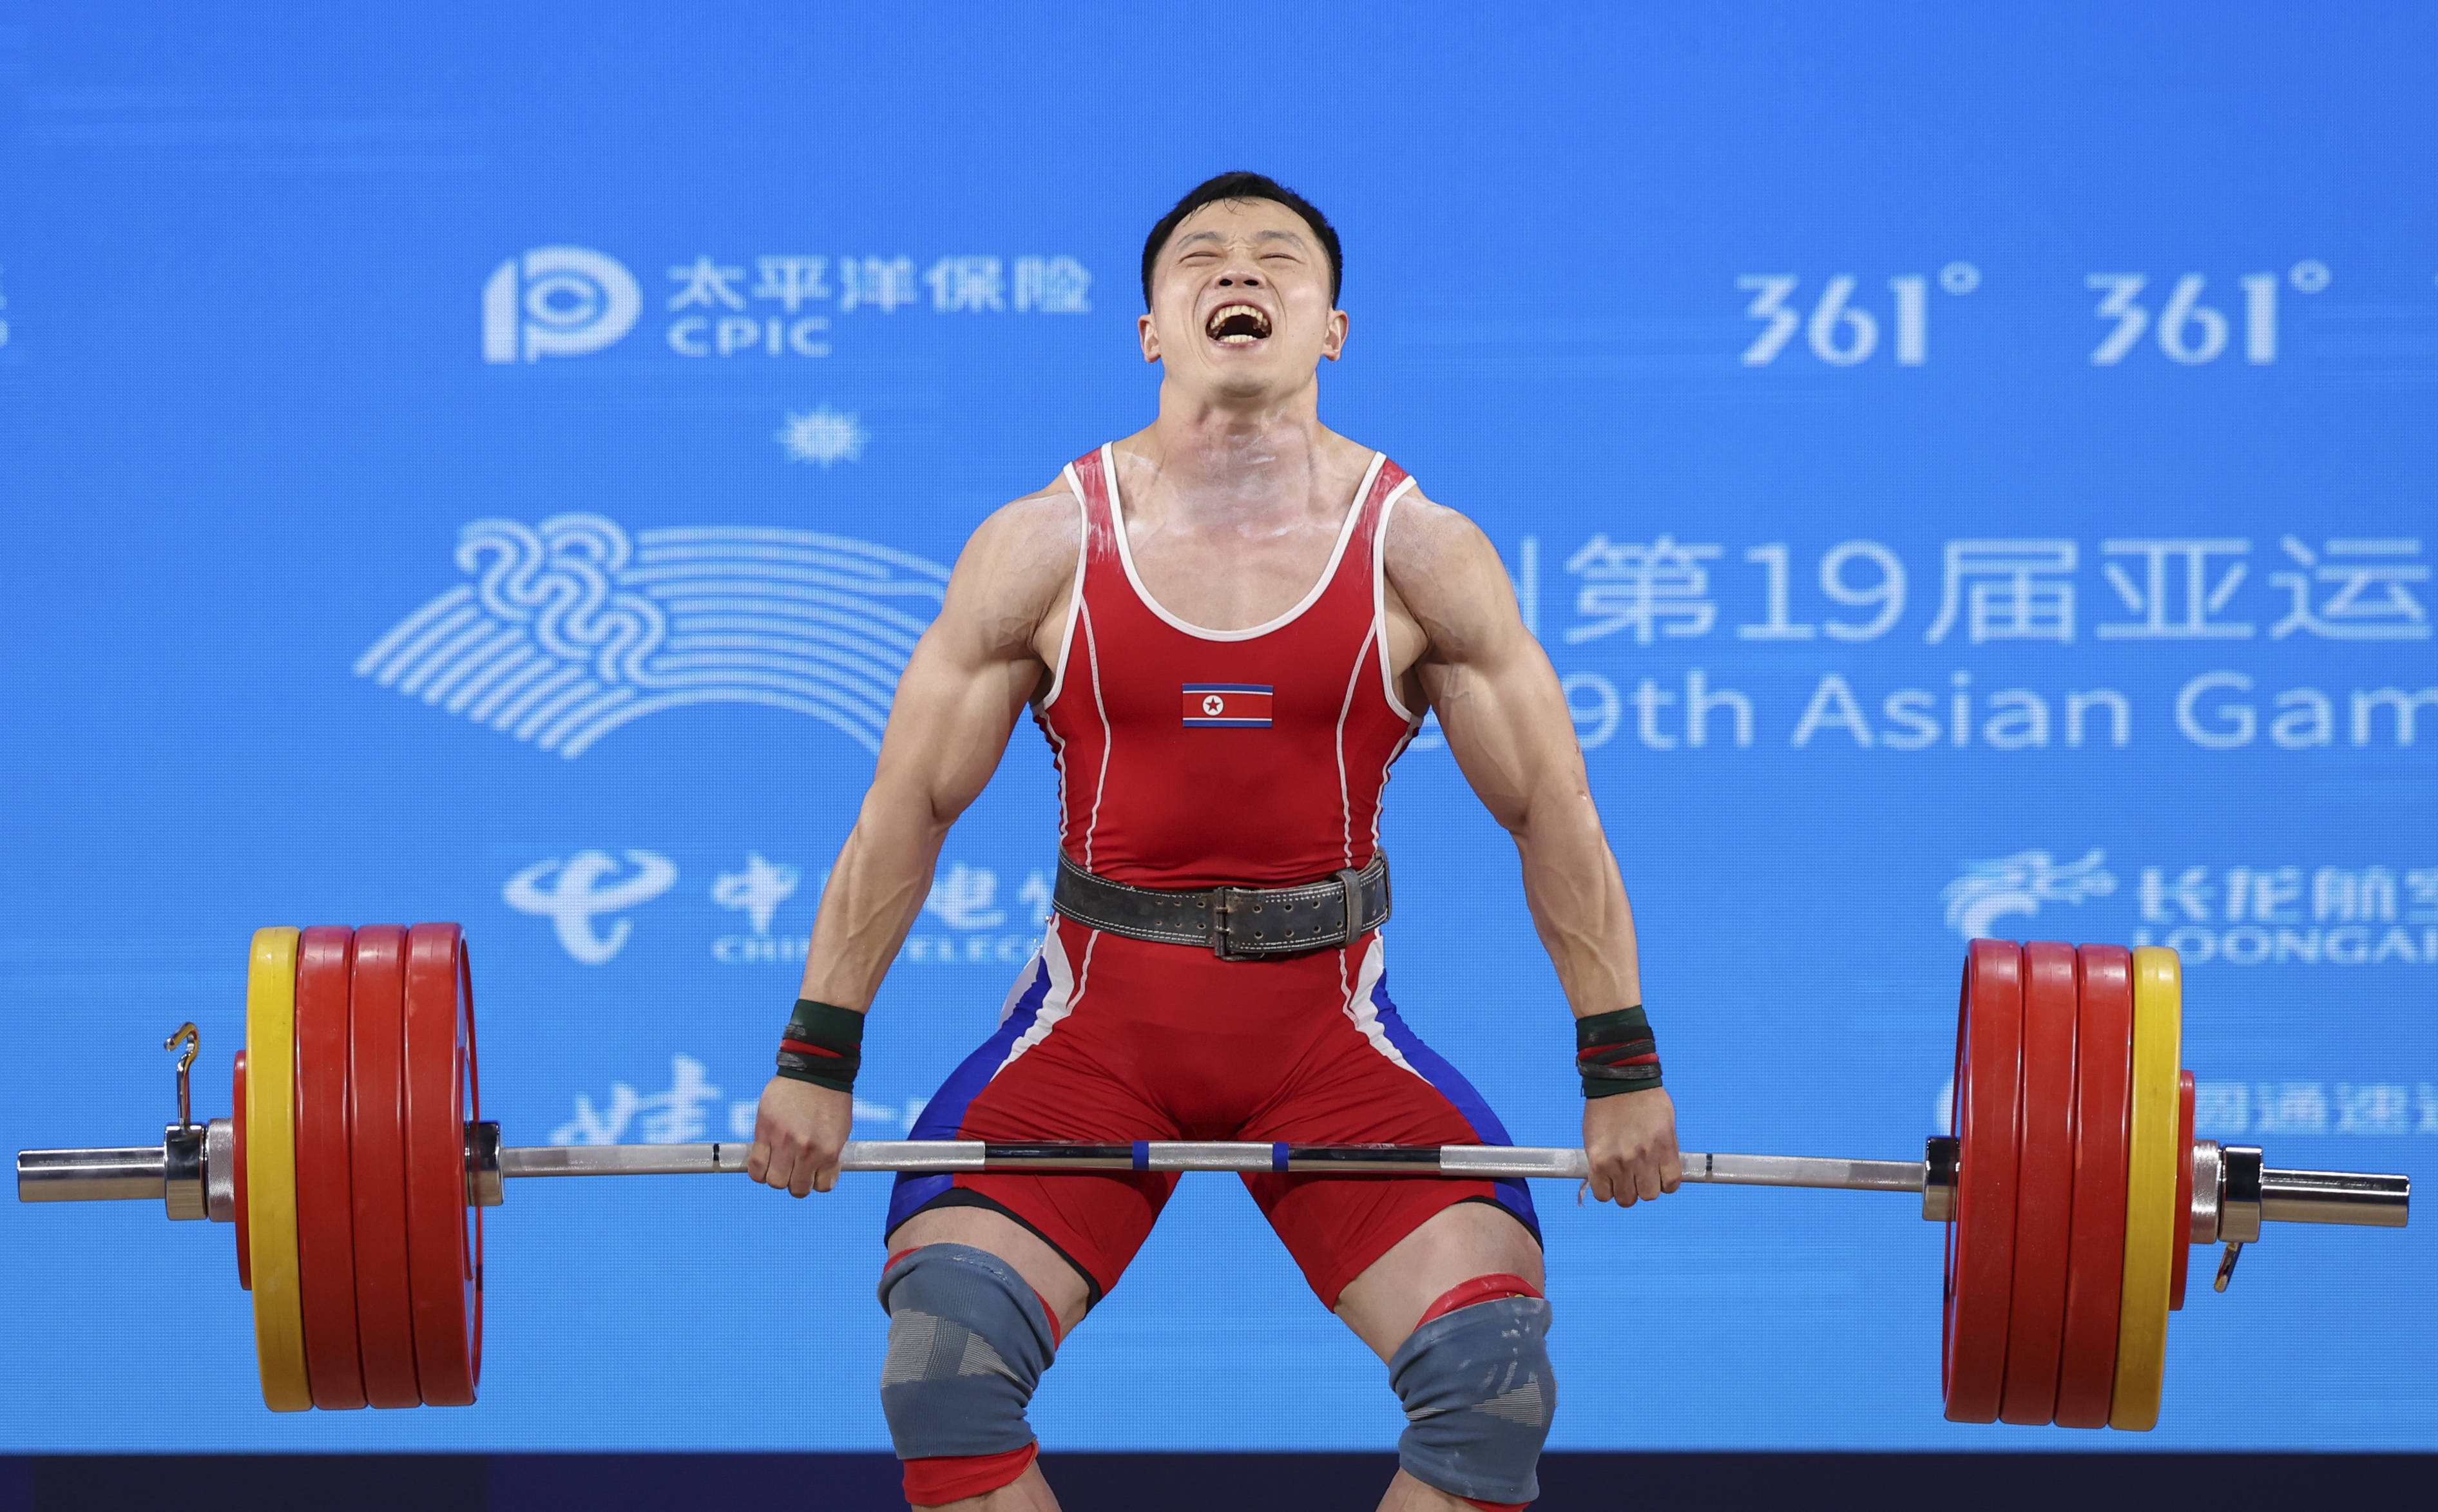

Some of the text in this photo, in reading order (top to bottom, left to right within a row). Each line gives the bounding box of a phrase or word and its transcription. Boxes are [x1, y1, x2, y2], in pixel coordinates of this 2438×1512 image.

[666, 255, 1093, 312] 太平洋保险
[666, 316, 832, 358] CPIC
[1509, 533, 2433, 645] 第19届亚运
[1562, 668, 2438, 751] 9th Asian Gam
